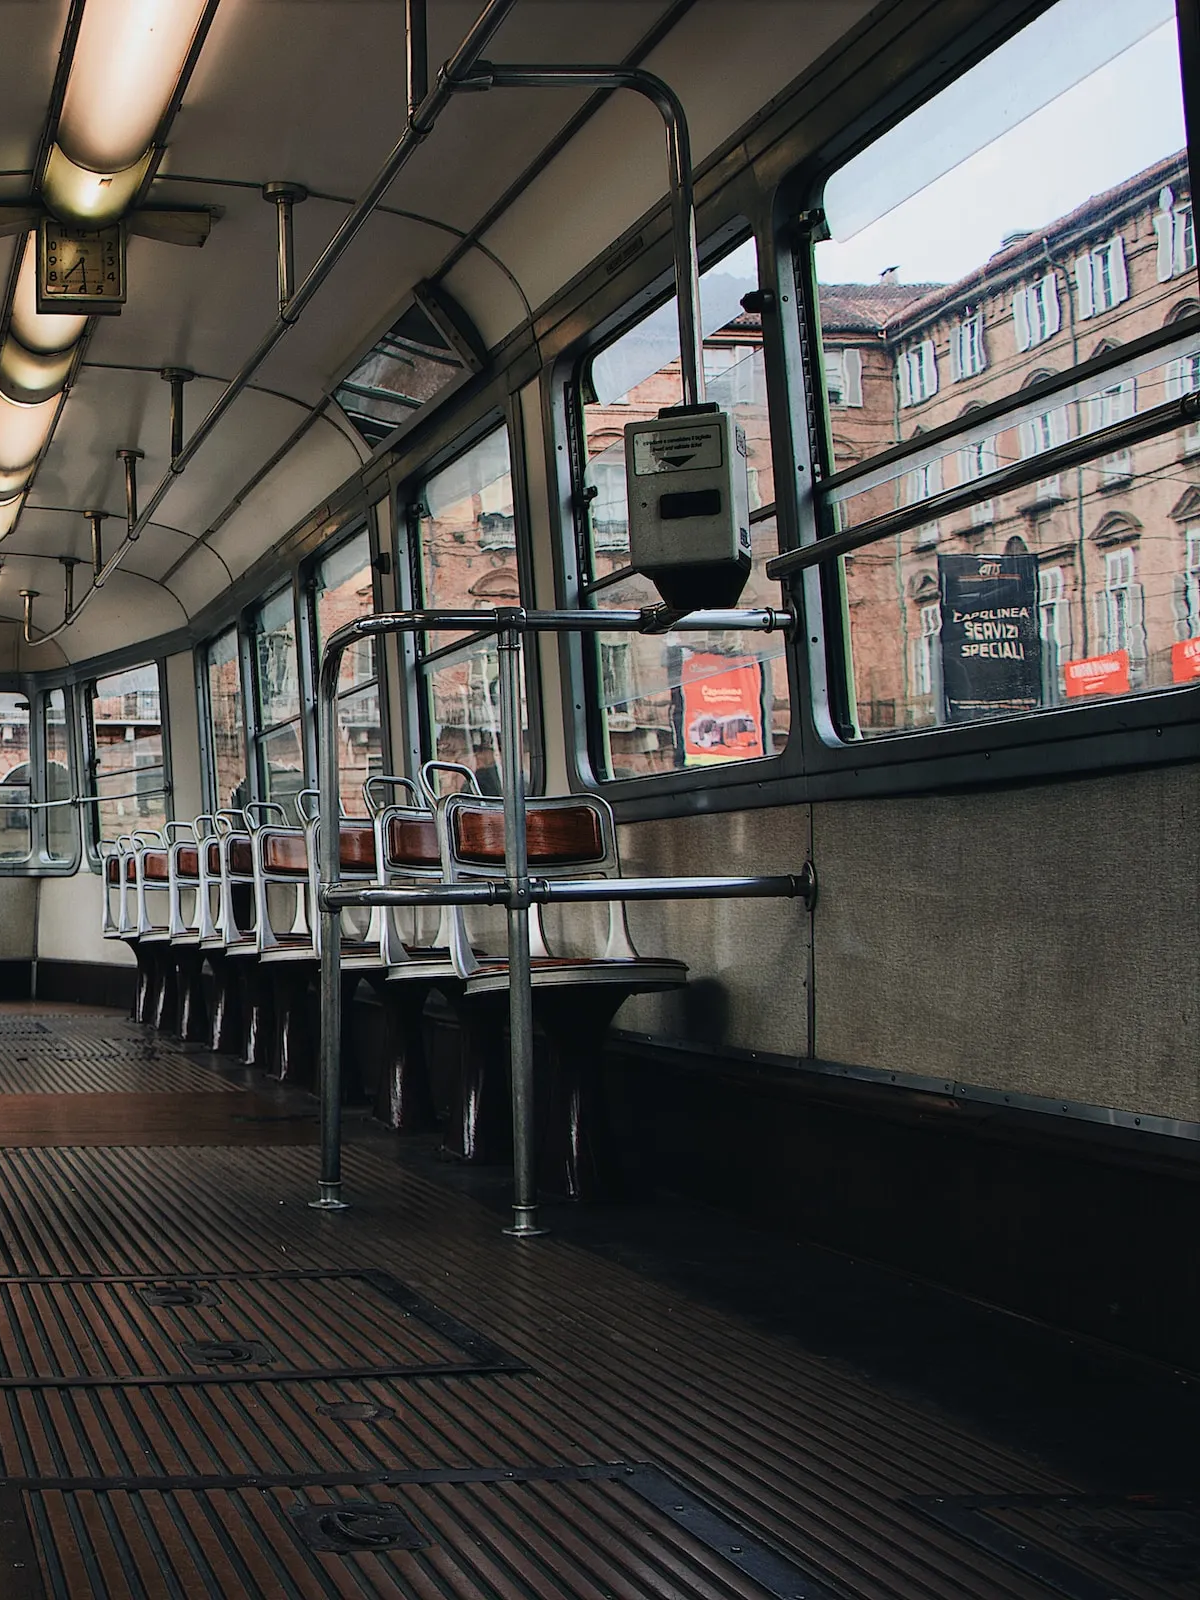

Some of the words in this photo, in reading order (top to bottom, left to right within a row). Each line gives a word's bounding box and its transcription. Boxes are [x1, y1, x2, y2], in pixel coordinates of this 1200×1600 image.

[106, 241, 113, 251] 2
[48, 256, 57, 266] 9
[106, 256, 115, 266] 3
[49, 271, 58, 281] 8
[106, 271, 116, 281] 4
[61, 285, 69, 293] 7
[96, 285, 104, 294] 5
[952, 606, 1030, 623] CAPOLINEA
[964, 621, 1019, 640] SERVIZI
[961, 642, 1025, 660] SPECIALI
